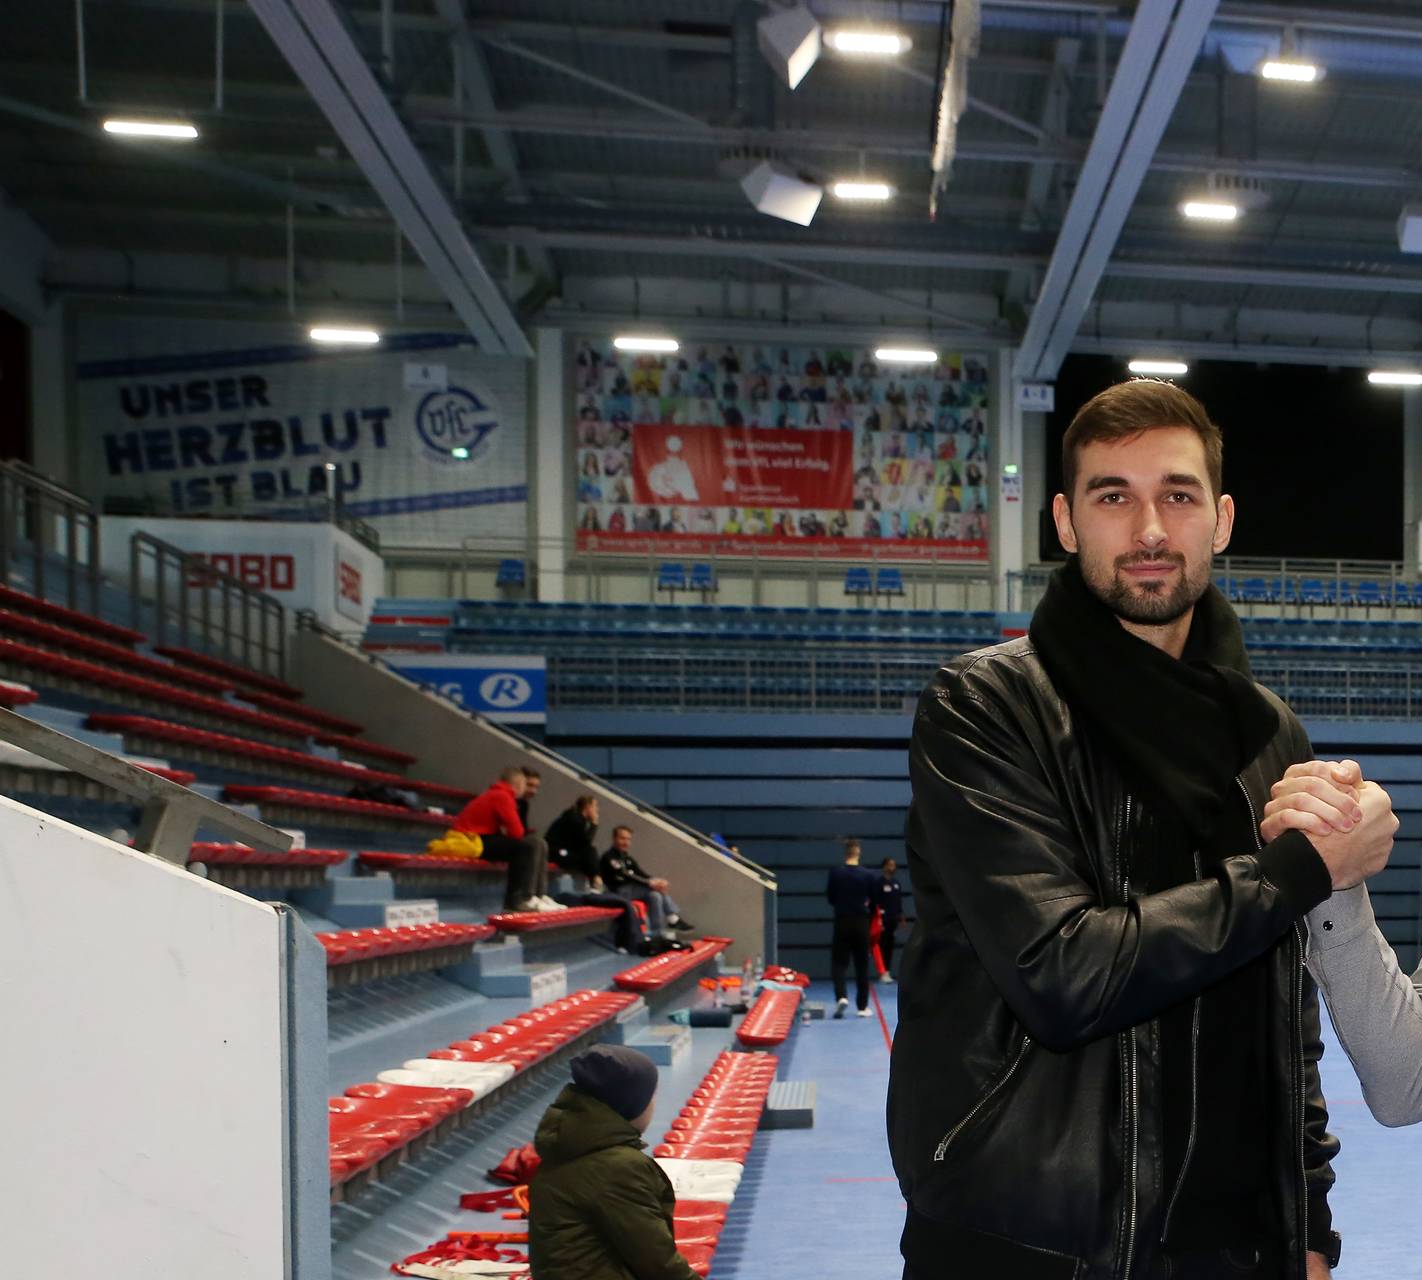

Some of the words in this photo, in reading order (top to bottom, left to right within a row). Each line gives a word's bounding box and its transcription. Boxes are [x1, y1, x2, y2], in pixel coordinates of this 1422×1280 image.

[119, 374, 271, 419] UNSER
[102, 405, 393, 476] HERZBLUT
[170, 473, 238, 511] IST
[251, 461, 362, 501] BLAU
